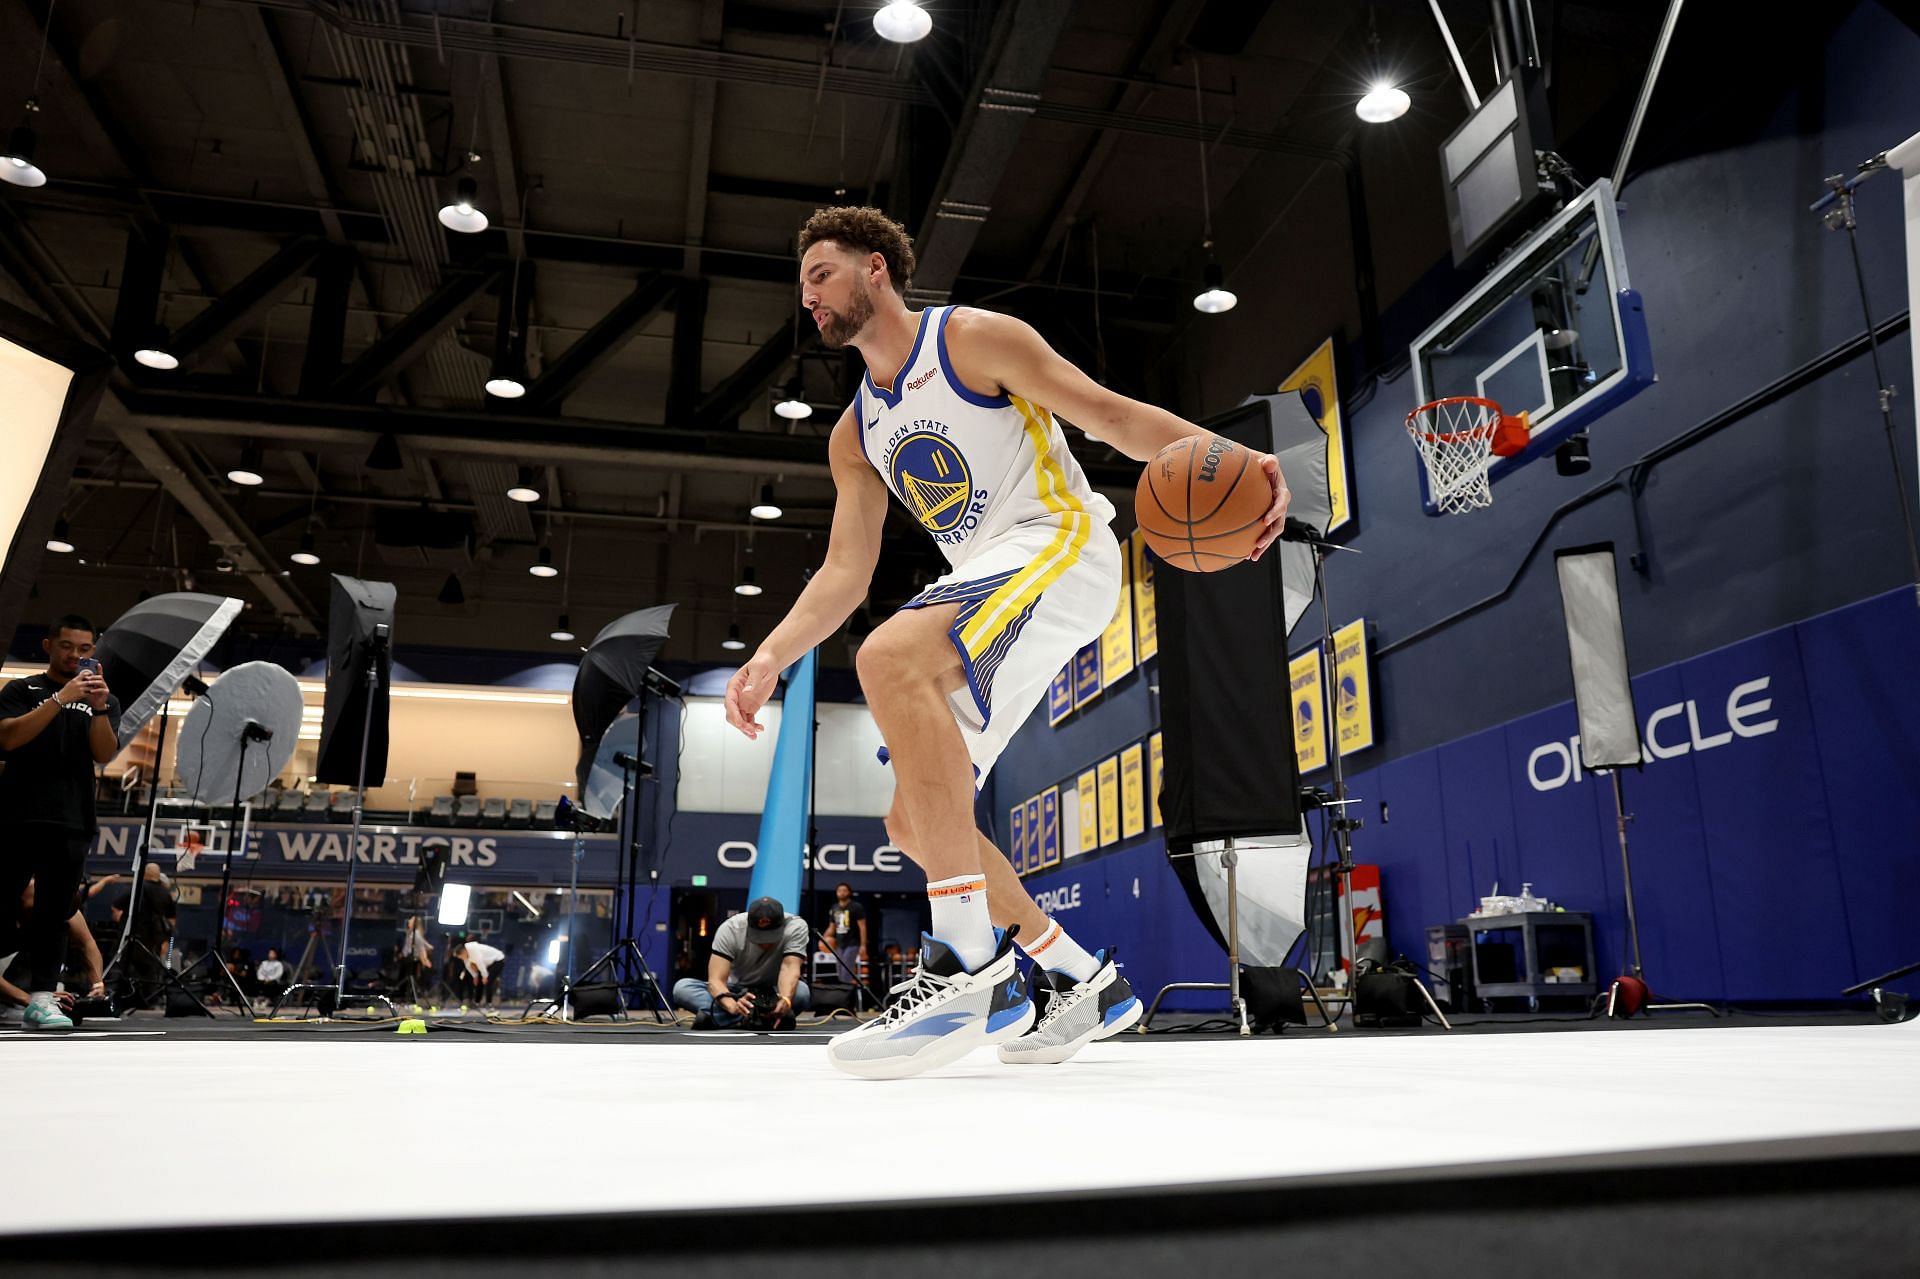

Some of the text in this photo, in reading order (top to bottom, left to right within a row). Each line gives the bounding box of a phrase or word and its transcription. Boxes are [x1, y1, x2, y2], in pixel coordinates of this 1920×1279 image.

[907, 367, 938, 391] Rakuten
[914, 420, 949, 435] STATE
[931, 449, 950, 478] 11
[934, 489, 988, 545] ARRIORS
[1528, 676, 1779, 792] OCLE
[1132, 877, 1140, 899] 4
